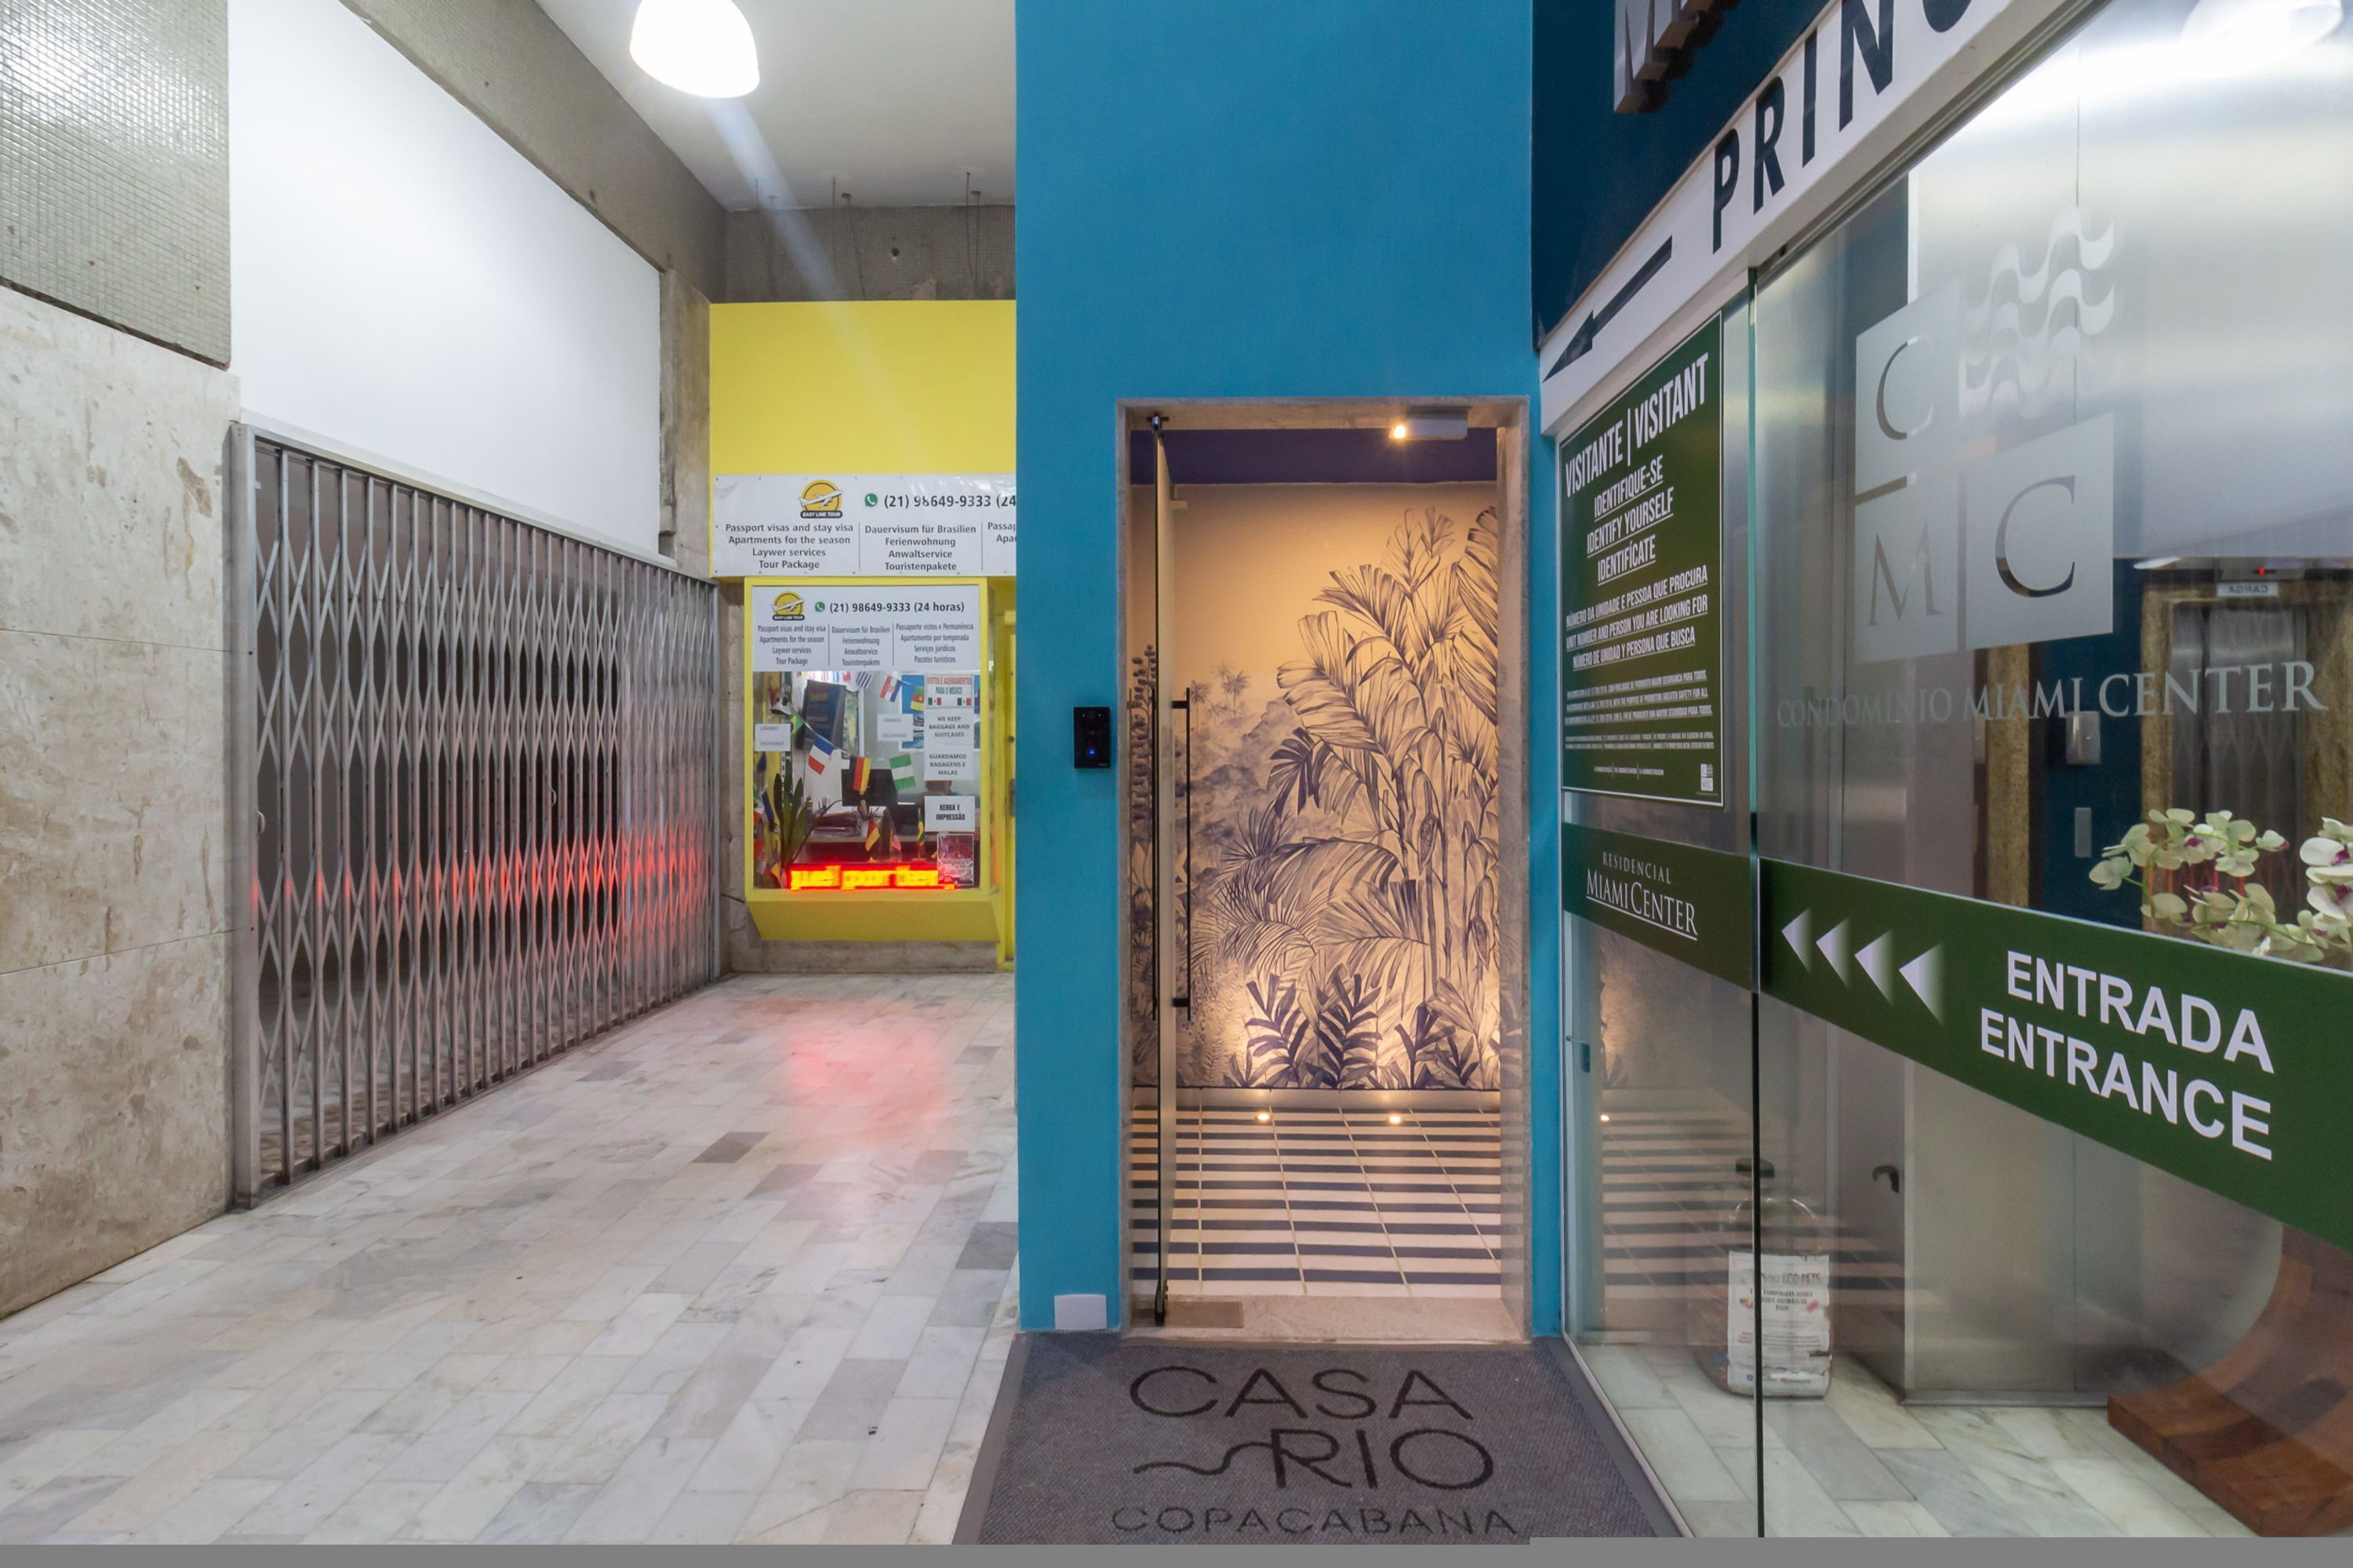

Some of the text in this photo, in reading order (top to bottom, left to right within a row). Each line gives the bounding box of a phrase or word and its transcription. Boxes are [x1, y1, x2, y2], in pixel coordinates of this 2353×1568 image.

[1712, 0, 1970, 254] PRIN
[1566, 352, 1708, 498] VISITANTE VISITANT
[885, 494, 909, 509] (21)
[914, 495, 991, 508] 98649-9333
[1595, 454, 1664, 518] IDENTIFIQUE-SE
[726, 523, 853, 534] Passport visas and stay visa
[865, 525, 976, 534] Dauervisum für Brasilien
[1587, 486, 1674, 555] IDENTIFY YOURSELF
[1995, 475, 2075, 597] C
[729, 536, 782, 546] Apartments
[785, 536, 798, 544] for
[800, 536, 816, 544] the
[752, 548, 786, 558] Laywer
[886, 537, 956, 548] Ferienwohnung
[889, 550, 953, 558] Anwaltservice
[759, 560, 820, 570] Tour Package
[885, 562, 957, 572] Touristenpakete
[1598, 534, 1656, 582] IDENTIFÍCATE
[830, 601, 965, 613] (21) 98649-9333 (24 horas)
[1587, 608, 1595, 621] DA
[1595, 596, 1620, 618] UNIDADE
[1621, 594, 1625, 609] E
[1627, 586, 1652, 608] PESSOA
[1653, 579, 1667, 598] QUE
[1670, 564, 1708, 593] PROCURA
[805, 625, 815, 634] stay
[1609, 618, 1631, 638] PERSON
[1632, 613, 1645, 631] YOU
[1646, 609, 1658, 628] ARE
[1660, 600, 1690, 624] LOOKING
[1692, 594, 1708, 614] FOR
[773, 647, 791, 656] Laywer
[1620, 643, 1625, 657] Y
[1627, 636, 1655, 657] PERSONA
[1656, 632, 1669, 652] QUE
[1671, 626, 1696, 647] BUSCA
[788, 657, 809, 667] Package
[1962, 676, 2083, 722] MIAMI
[2098, 660, 2329, 718] CENTER
[1602, 851, 1671, 885] RESIDENCIAL
[2007, 950, 2275, 1075] ENTRADA
[1980, 1007, 2272, 1161] ENTRANCE
[1129, 1366, 1474, 1420] CASA
[1271, 1428, 1493, 1490] RIO
[1111, 1505, 1518, 1536] COPACABANA
